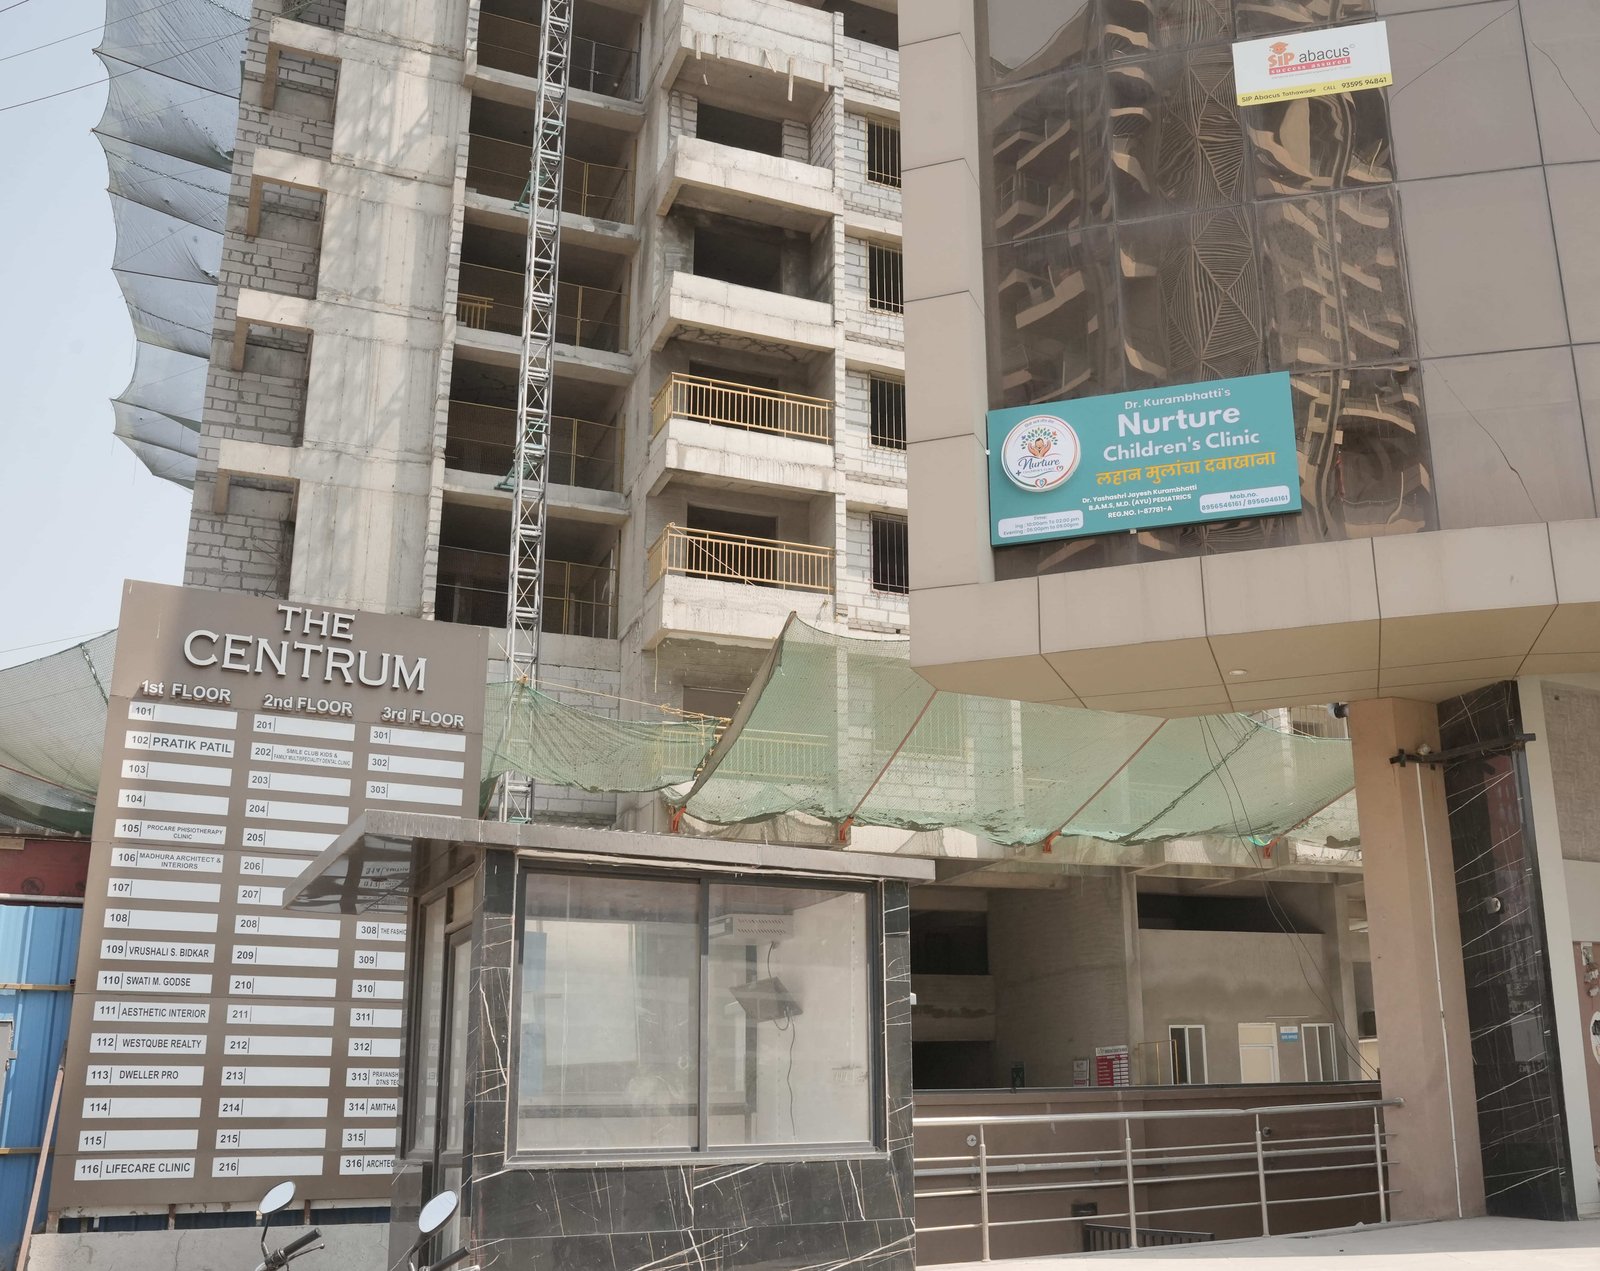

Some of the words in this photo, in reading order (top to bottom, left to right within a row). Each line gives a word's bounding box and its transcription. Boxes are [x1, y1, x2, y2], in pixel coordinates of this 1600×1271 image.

[1299, 46, 1350, 63] abacus
[1271, 66, 1306, 74] success
[1311, 58, 1348, 68] assured
[1254, 93, 1281, 101] Abacus
[1341, 80, 1363, 89] 93595
[1364, 77, 1387, 85] 94841
[1124, 401, 1141, 410] Dr.
[1143, 387, 1231, 407] Kurambhatti's
[1117, 406, 1241, 438] Nurture
[1103, 436, 1201, 462] Children's
[1205, 429, 1260, 449] Clinic
[1018, 458, 1060, 470] Nurture
[1096, 467, 1142, 486] लहान
[1145, 460, 1201, 484] मुलांचा
[1205, 451, 1276, 473] दवाखाना
[1093, 493, 1127, 502] Yashashri
[1127, 490, 1152, 499] Jayesh
[1153, 484, 1197, 495] Kurambhatti
[1131, 497, 1152, 507] (AYU)
[1152, 493, 1192, 503] PEDIATRICS
[277, 604, 356, 640] THE
[184, 629, 427, 692] CENTRUM
[141, 680, 164, 694] 1st
[172, 683, 231, 702] FLOOR
[264, 694, 293, 708] 2nd
[297, 697, 353, 715] FLOOR
[135, 707, 152, 716] 101
[383, 706, 407, 721] 3rd
[412, 709, 464, 727] FLOOR
[256, 721, 272, 729] 201
[373, 731, 388, 739] 301
[132, 735, 149, 745] 102
[152, 737, 197, 750] PRATIK
[200, 741, 232, 753] PATIL
[255, 747, 271, 757] 202
[372, 758, 387, 767] 302
[128, 764, 146, 774] 103
[252, 775, 268, 784] 203
[370, 785, 386, 794] 303
[126, 794, 143, 803] 104
[249, 804, 265, 813] 204
[122, 824, 139, 833] 105
[147, 824, 176, 832] PROCARE
[177, 826, 223, 835] PHISIOTHERAPY
[247, 833, 263, 842] 205
[118, 853, 136, 862] 106
[175, 855, 214, 863] ARCHITECT
[244, 861, 260, 870] 206
[112, 883, 130, 892] 107
[242, 890, 259, 898] 207
[110, 914, 128, 922] 108
[240, 919, 257, 928] 208
[361, 926, 377, 934] 308
[106, 945, 124, 954] 109
[129, 946, 169, 956] VRUSHALI
[170, 947, 178, 957] S.
[179, 948, 209, 958] BIDKAR
[236, 950, 254, 960] 209
[359, 956, 374, 964] 309
[103, 976, 120, 985] 110
[126, 976, 150, 985] SWATI
[152, 977, 161, 986] M.
[163, 977, 191, 987] GODSE
[234, 981, 252, 989] 210
[357, 984, 373, 993] 310
[100, 1006, 116, 1014] 111
[121, 1007, 167, 1017] AESTHETIC
[168, 1008, 206, 1018] INTERIOR
[232, 1010, 248, 1019] 211
[355, 1013, 370, 1021] 311
[97, 1038, 114, 1047] 112
[122, 1038, 168, 1048] WESTQUBE
[171, 1039, 202, 1049] REALTY
[230, 1041, 248, 1050] 212
[354, 1043, 370, 1051] 312
[91, 1071, 109, 1080] 113
[119, 1070, 159, 1079] DWELLER
[161, 1070, 179, 1079] PRO
[226, 1071, 243, 1080] 213
[351, 1072, 368, 1081] 313
[90, 1103, 107, 1112] 114
[222, 1103, 240, 1112] 214
[348, 1103, 365, 1111] 314
[370, 1103, 396, 1111] AMITHA
[84, 1136, 102, 1145] 115
[220, 1134, 238, 1143] 215
[347, 1133, 364, 1142] 315
[81, 1164, 99, 1174] 116
[105, 1163, 155, 1174] LIFECARE
[158, 1162, 190, 1173] CLINIC
[219, 1162, 237, 1172] 216
[345, 1159, 362, 1168] 316
